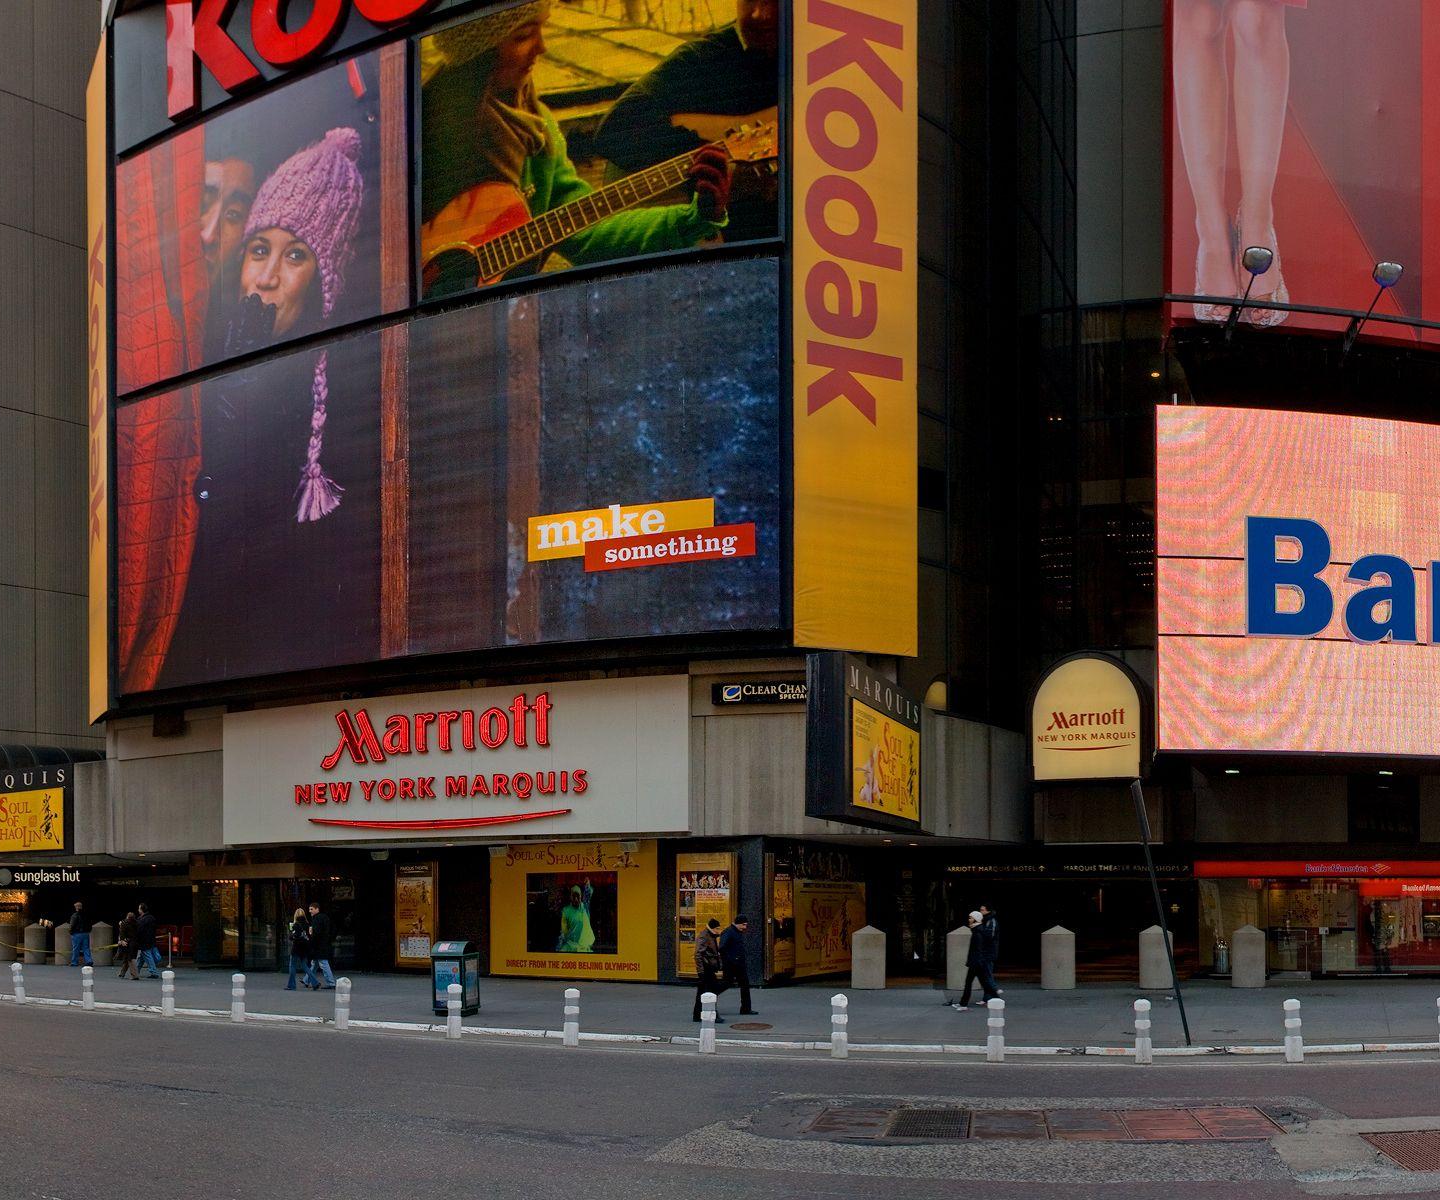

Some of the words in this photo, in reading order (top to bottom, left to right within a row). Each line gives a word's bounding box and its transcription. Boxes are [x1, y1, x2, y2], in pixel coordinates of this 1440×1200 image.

[806, 0, 904, 426] Kodak
[537, 504, 665, 549] make
[604, 532, 739, 566] something
[850, 665, 919, 725] MARQUIS
[320, 691, 553, 770] Marriott
[1046, 707, 1126, 732] Marriott
[1037, 733, 1058, 743] NEW
[1060, 732, 1088, 743] YORK
[1089, 730, 1137, 742] MARQUIS
[294, 780, 352, 805] NEW
[360, 775, 436, 802] YORK
[445, 768, 589, 800] MARQUIS
[7, 815, 18, 827] OF
[505, 845, 534, 867] SOUL
[535, 850, 546, 860] OF
[546, 844, 594, 871] SHAOLIN
[14, 869, 61, 886] sunglass
[62, 869, 81, 882] hut
[506, 959, 527, 968] DIRECT
[528, 960, 546, 969] FROM
[548, 960, 560, 969] THE
[578, 961, 603, 971] BEIJING
[604, 962, 641, 972] OLYMPICS!
